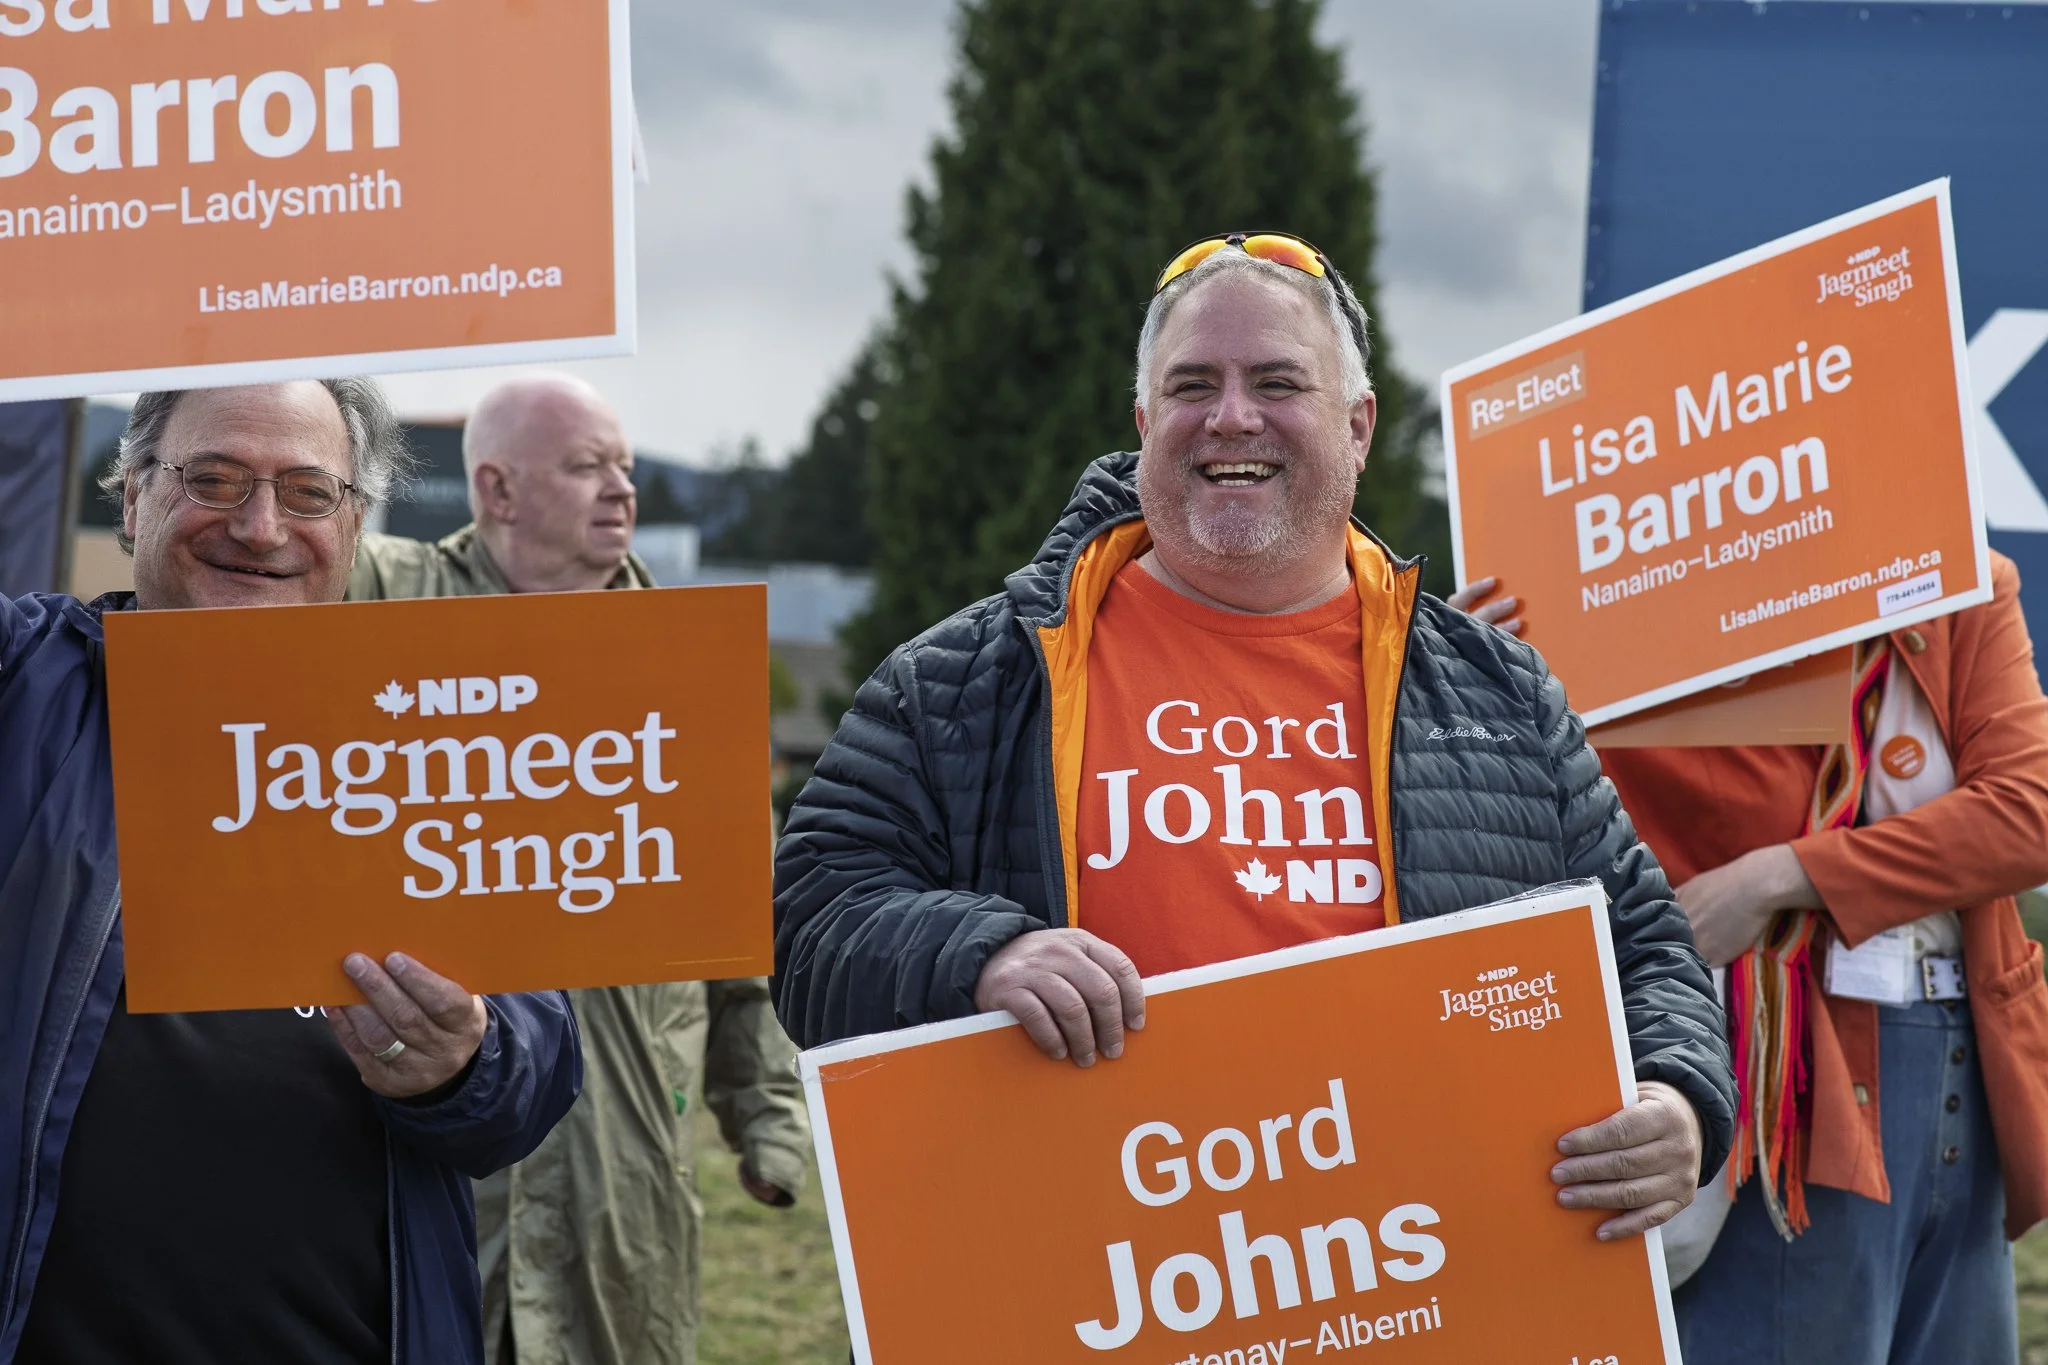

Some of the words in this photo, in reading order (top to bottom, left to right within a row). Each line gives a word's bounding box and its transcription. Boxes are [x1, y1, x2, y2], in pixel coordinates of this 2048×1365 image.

[200, 264, 561, 312] LisaMarieBarron.ndp.ca
[1817, 248, 1909, 303] Jagmeet
[1850, 271, 1912, 306] Singh
[1472, 365, 1581, 429] Re-Elect
[1539, 416, 1656, 496] Lisa
[1676, 341, 1851, 445] Marie
[1575, 437, 1828, 573] Barron
[1720, 551, 1941, 632] LisaMarieBarron.ndp.ca
[419, 675, 538, 716] NDP
[1147, 700, 1357, 759] Gord
[212, 711, 678, 835] Jagmeet
[404, 802, 681, 913] Singh
[1440, 972, 1557, 1020] Jagmeet
[1488, 966, 1518, 981] NDP
[1489, 998, 1562, 1031] Singh
[1121, 1078, 1356, 1206] Gord
[1075, 1204, 1445, 1350] Johns
